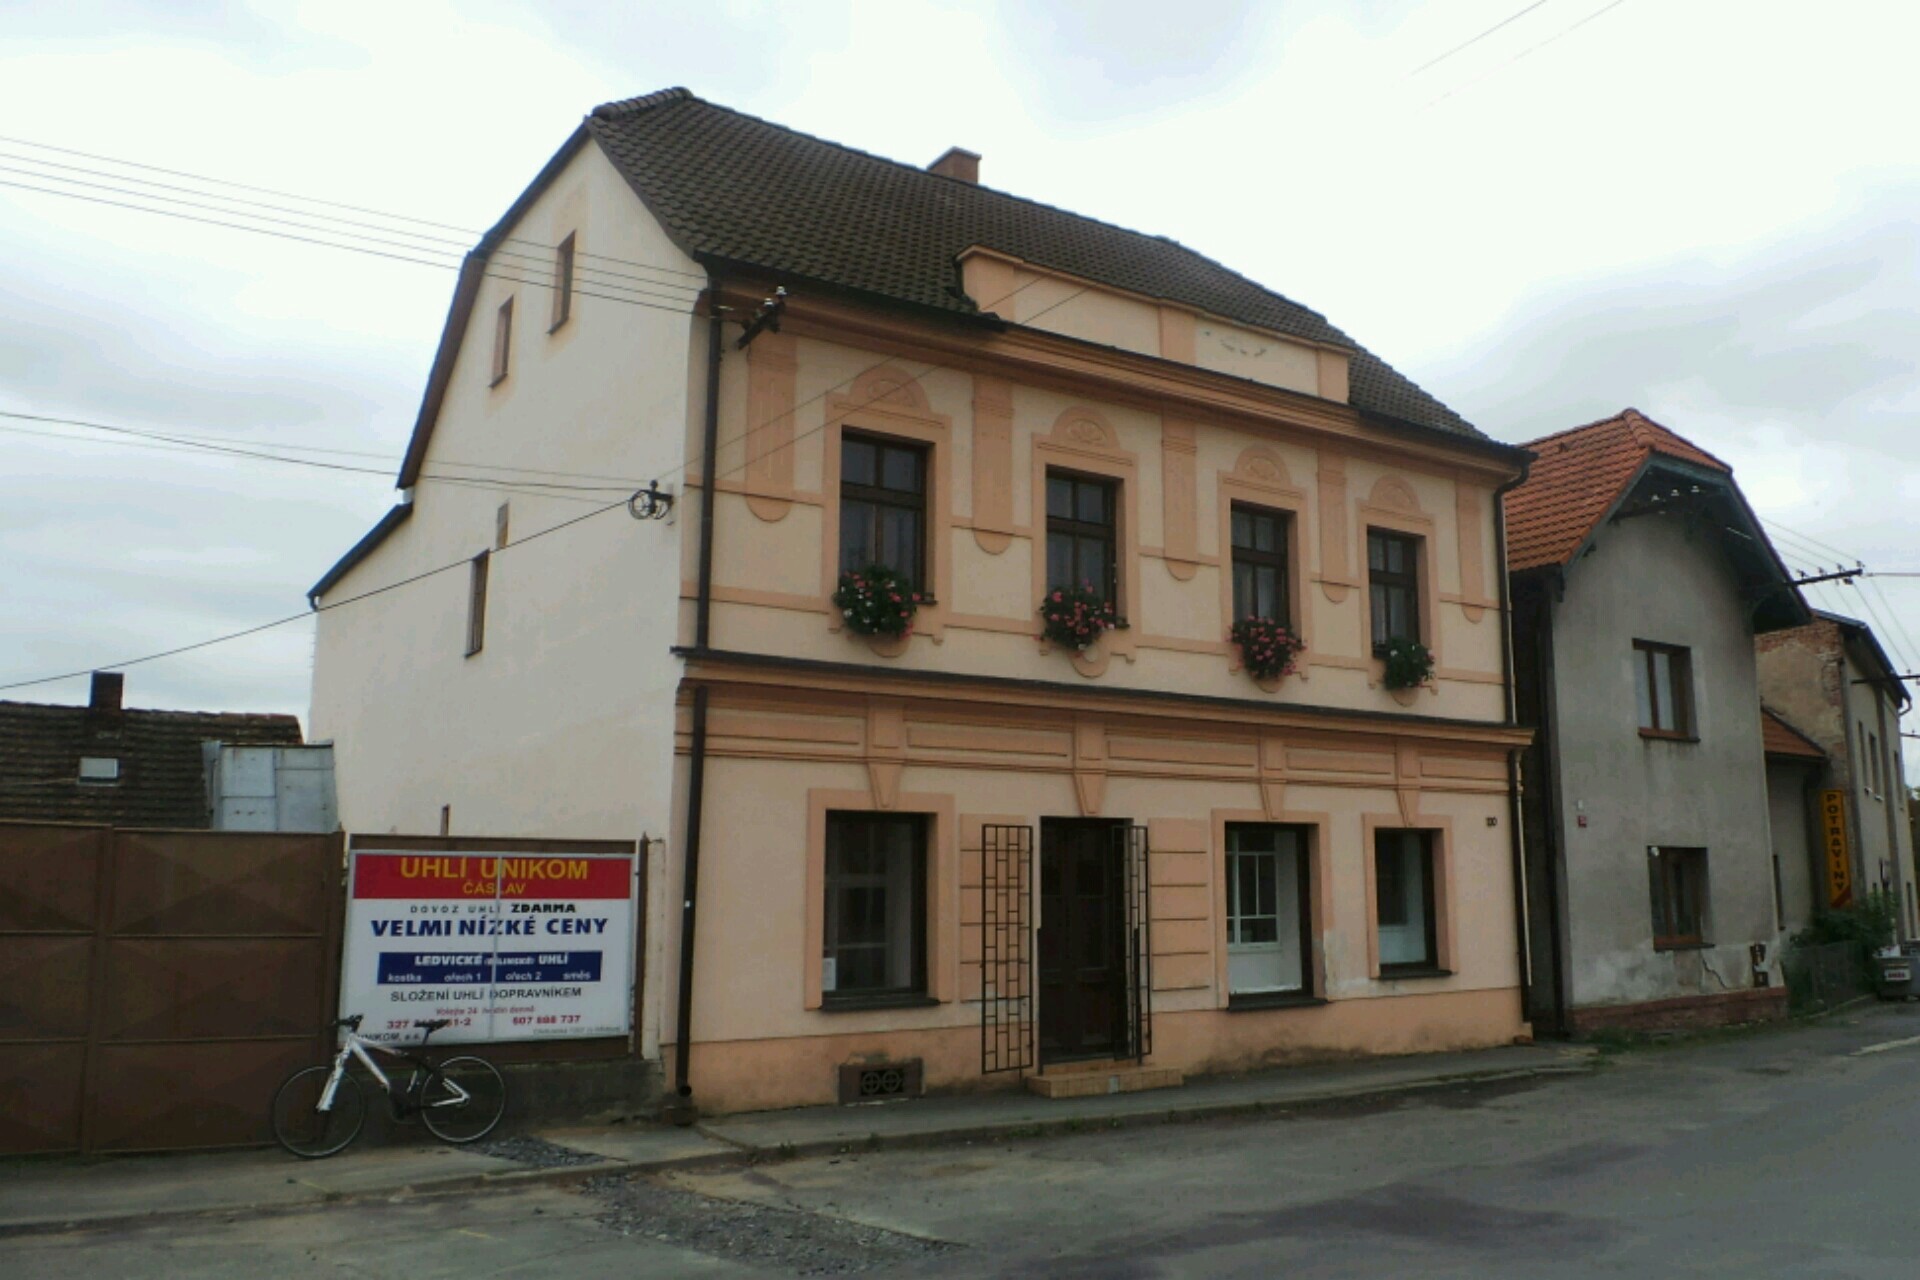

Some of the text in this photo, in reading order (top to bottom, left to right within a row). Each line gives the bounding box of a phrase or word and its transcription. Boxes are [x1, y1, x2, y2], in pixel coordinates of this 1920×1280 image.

[1827, 793, 1845, 890] POTRAVINY
[480, 857, 588, 881] UNIKOM
[462, 879, 526, 895] ČÁSAV
[410, 904, 459, 914] DOVOZ
[511, 903, 576, 913] ZDARMA
[370, 914, 608, 937] VELMI NÍZKÉ CENY
[414, 953, 483, 967] LEDVICKÉ
[538, 952, 569, 965] UHLÍ
[387, 972, 422, 982] kostka
[535, 971, 542, 981] 2
[391, 986, 582, 1002] SLOŽENÍ UHLÍ DOPRAVNÍKEM
[387, 1019, 408, 1030] 327
